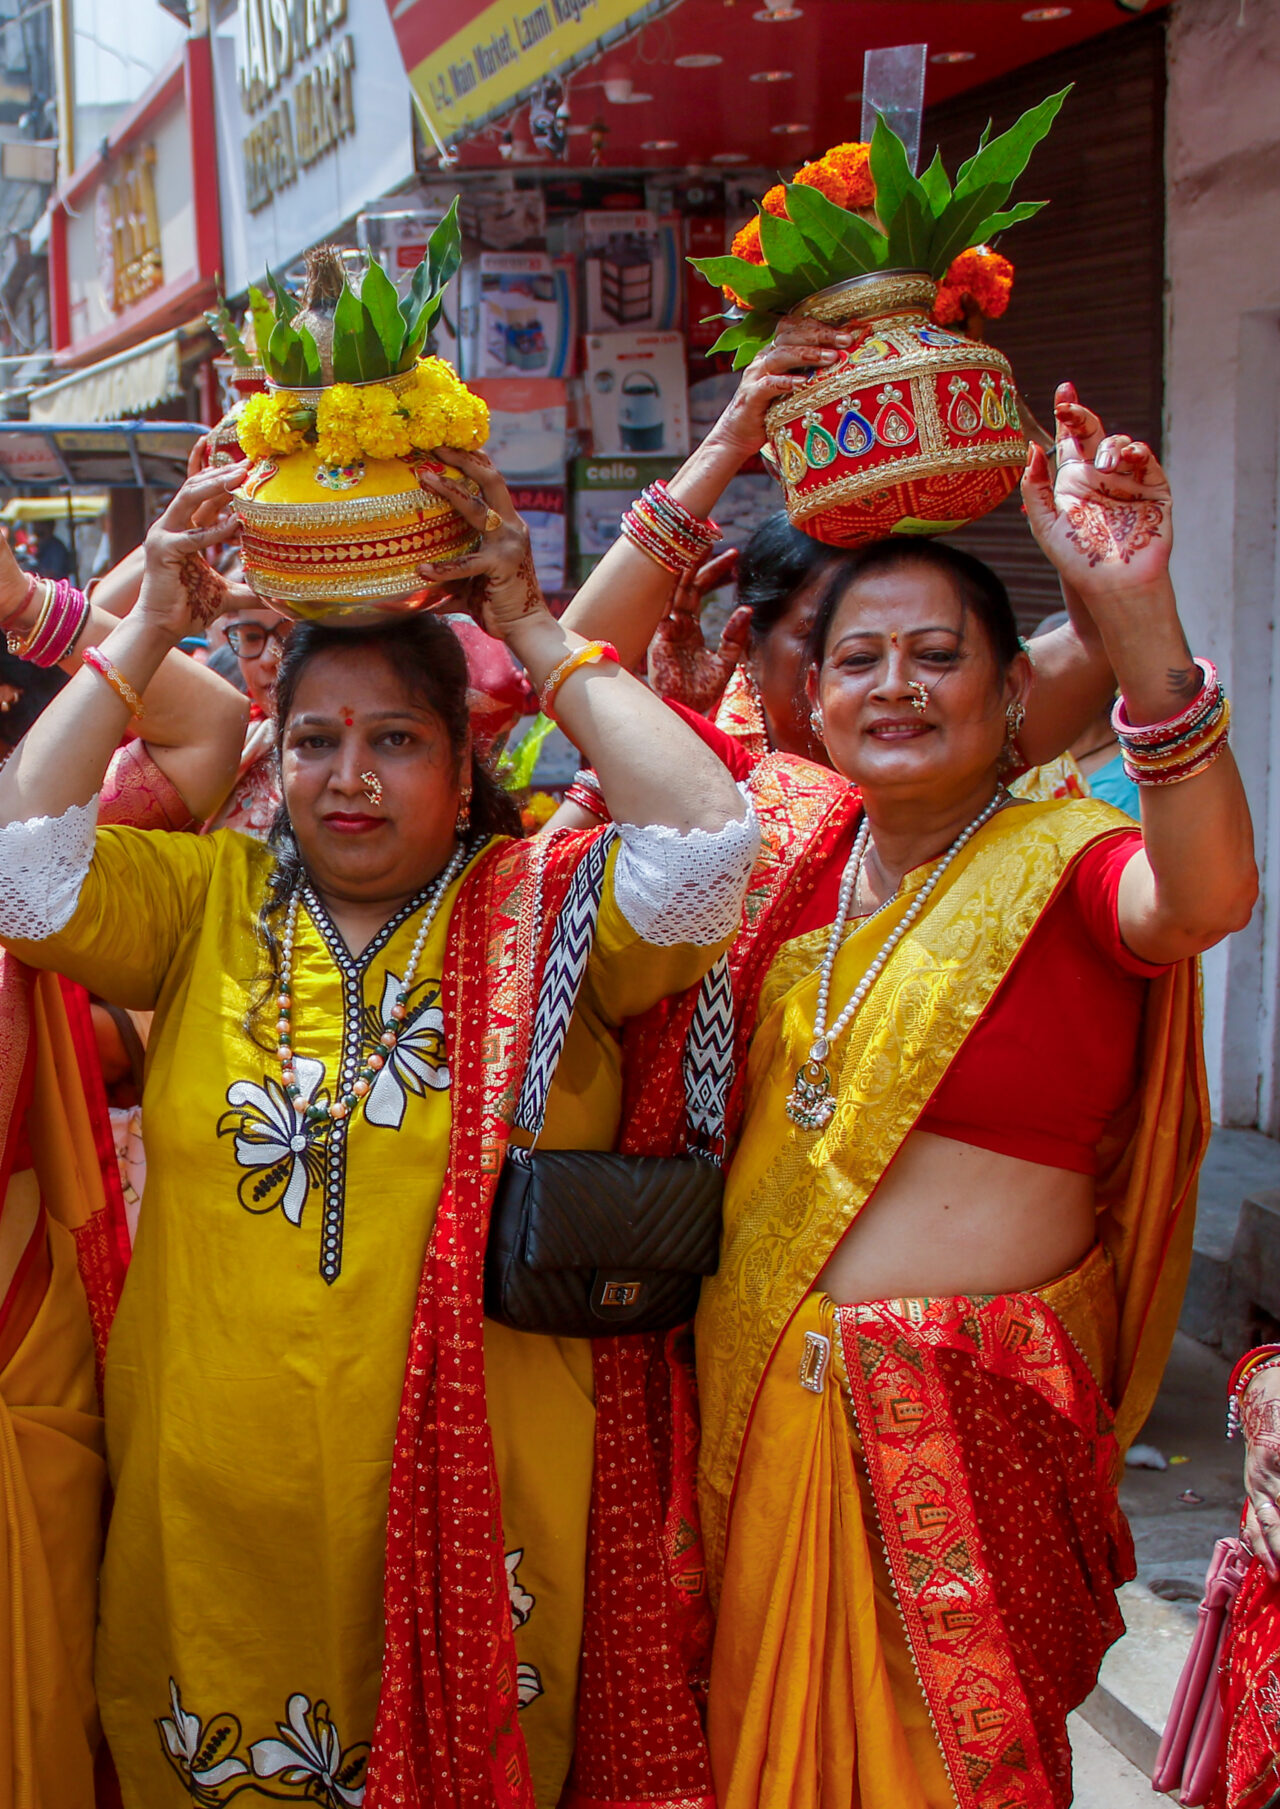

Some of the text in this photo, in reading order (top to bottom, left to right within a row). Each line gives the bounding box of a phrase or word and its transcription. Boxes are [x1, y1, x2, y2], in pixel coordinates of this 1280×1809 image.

[447, 58, 477, 100] Main
[472, 25, 518, 81] Market,
[512, 4, 553, 52] Laxmi
[551, 0, 598, 25] Nag,
[293, 33, 356, 170] MART
[586, 462, 637, 479] cello
